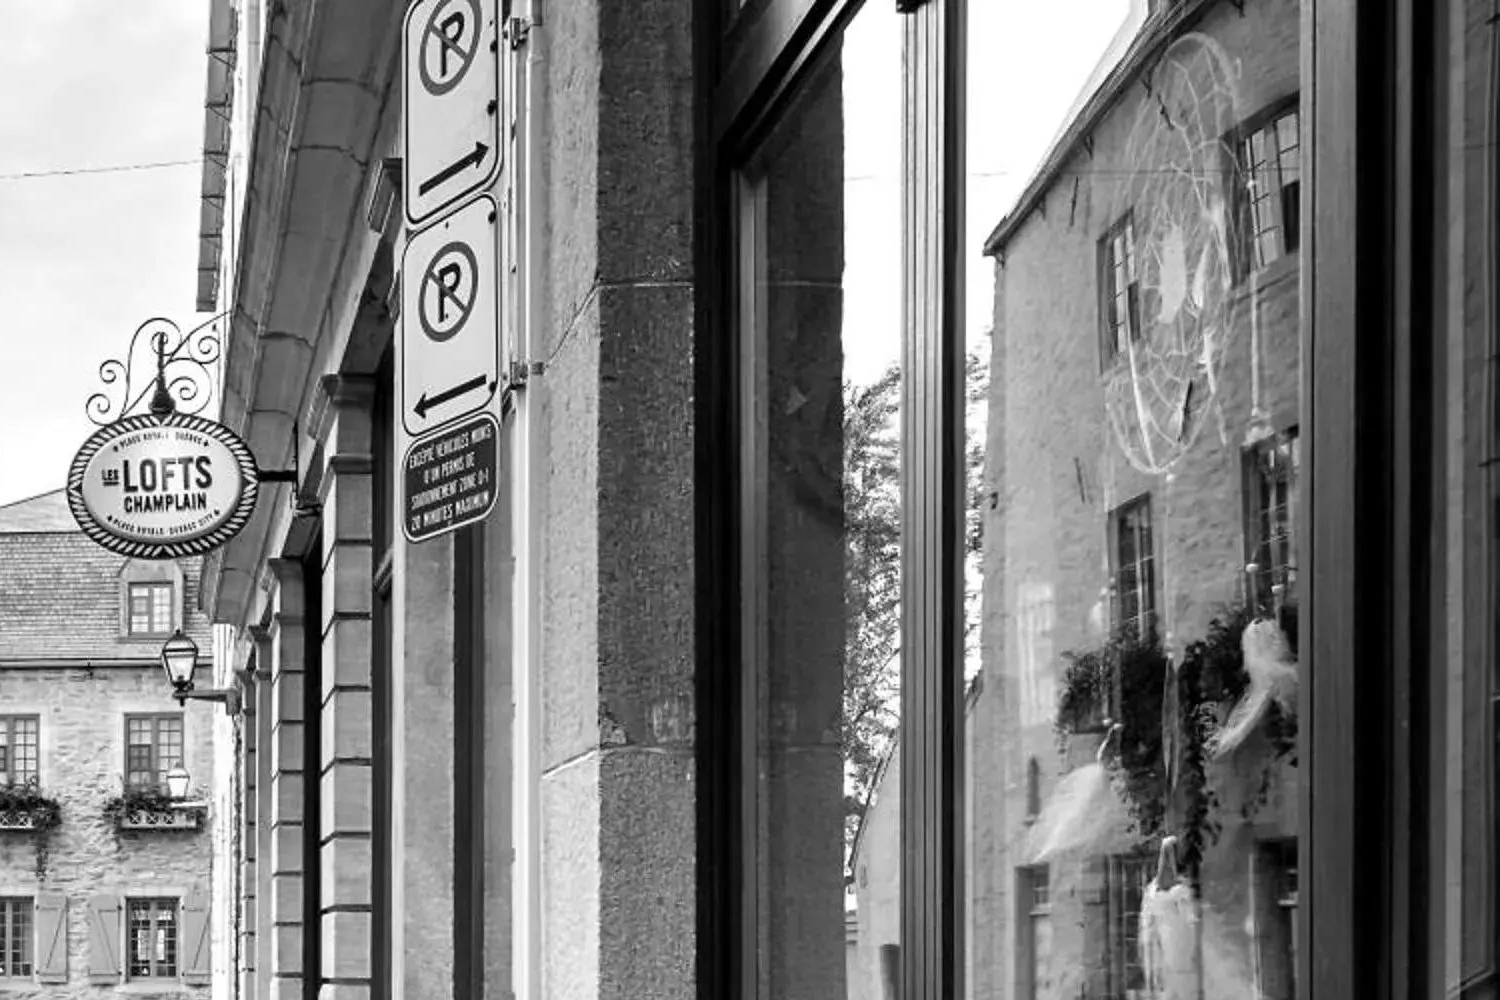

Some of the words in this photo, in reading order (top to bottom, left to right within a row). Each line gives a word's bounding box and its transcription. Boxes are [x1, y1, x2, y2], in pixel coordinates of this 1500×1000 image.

[101, 468, 120, 481] LES
[123, 455, 213, 493] LOFTS
[123, 492, 208, 514] CHAMPLAIN
